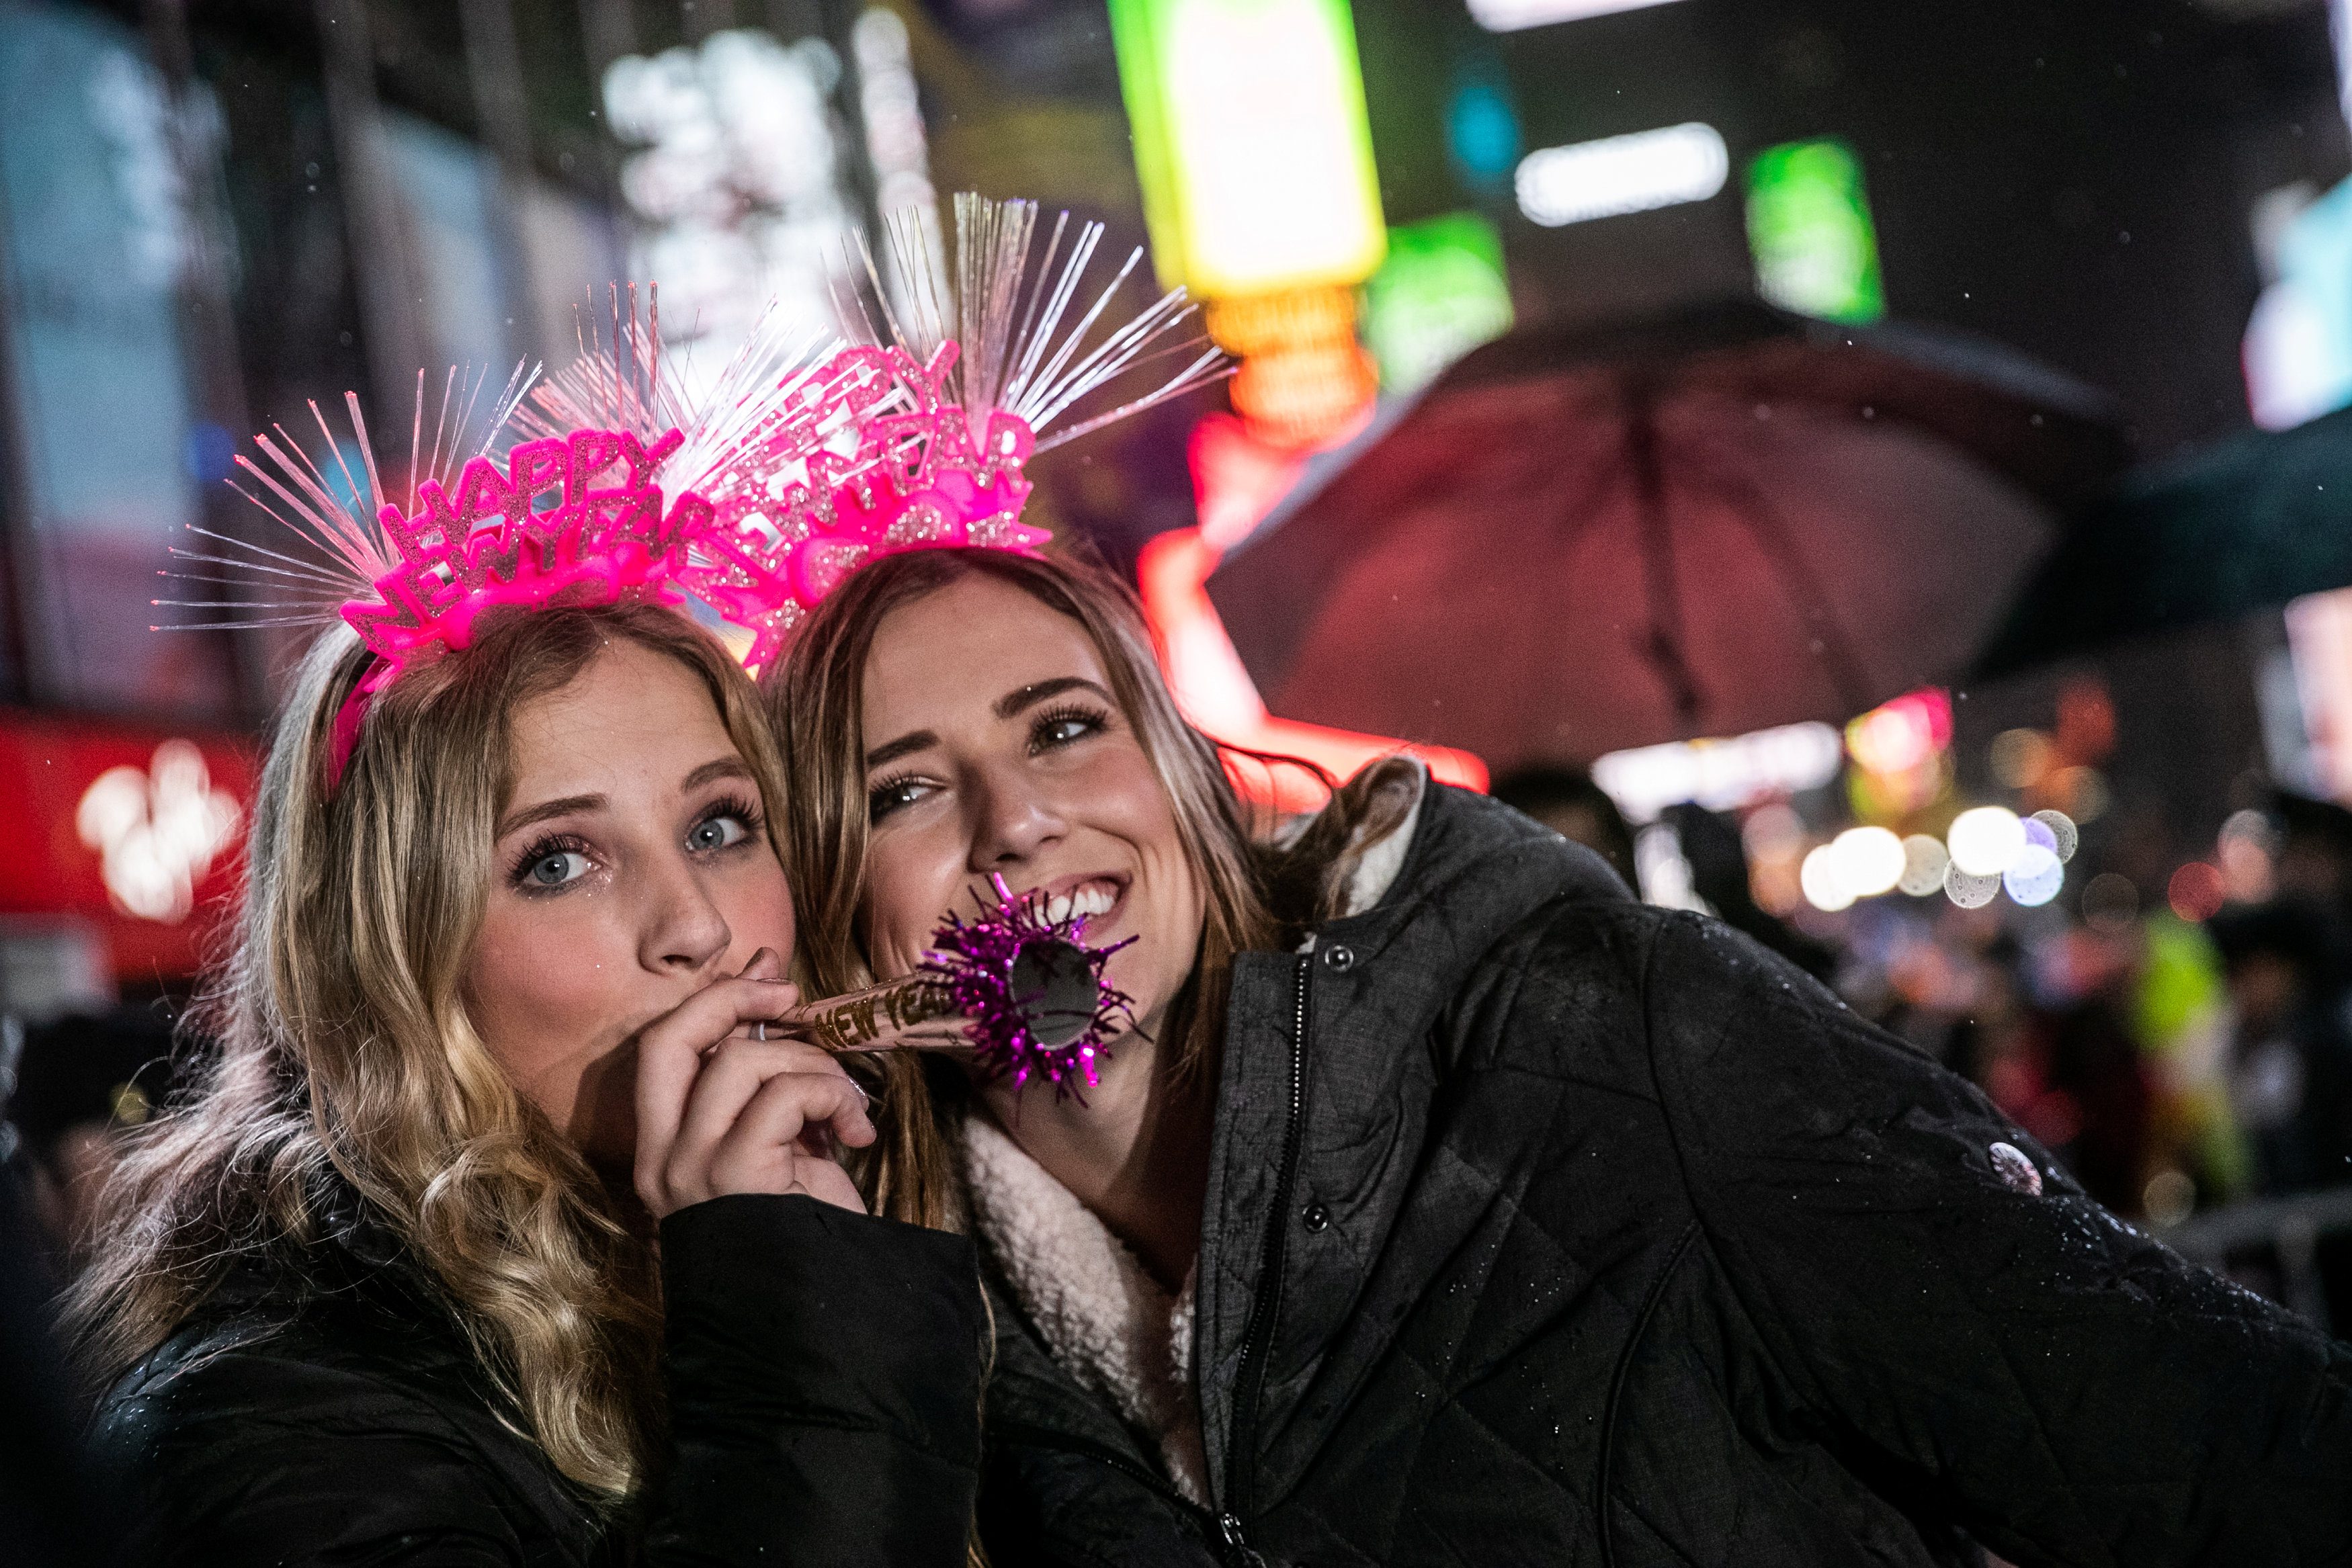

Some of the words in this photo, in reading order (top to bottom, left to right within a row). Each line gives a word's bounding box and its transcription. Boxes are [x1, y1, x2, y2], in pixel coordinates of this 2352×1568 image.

[376, 427, 685, 566] HAPPY
[339, 531, 527, 657] NEW
[523, 484, 716, 571] YEAR
[814, 994, 879, 1051] NEW
